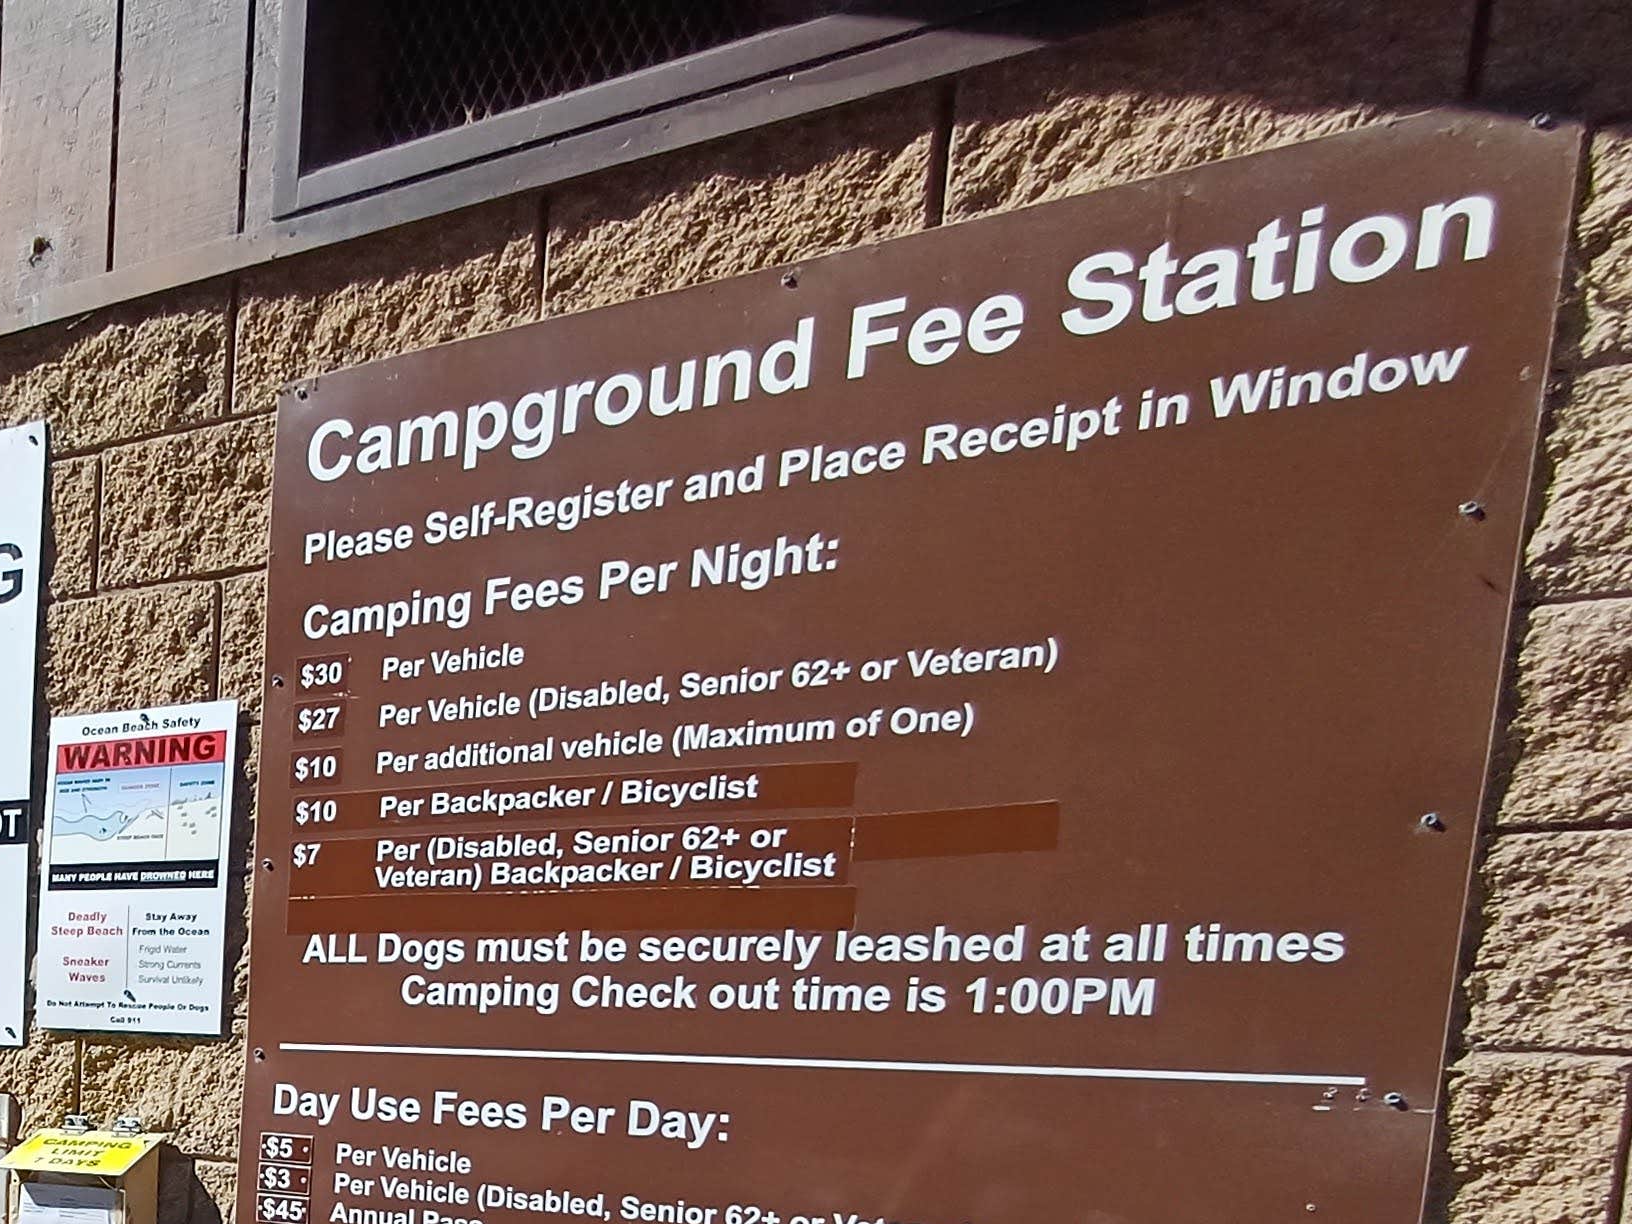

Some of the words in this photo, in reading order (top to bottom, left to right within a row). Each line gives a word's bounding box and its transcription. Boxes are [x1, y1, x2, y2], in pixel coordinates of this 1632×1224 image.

[308, 316, 814, 481] Campground
[848, 294, 1024, 378] Fee
[1062, 195, 1496, 334] Station
[305, 525, 413, 564] Please
[424, 478, 674, 544] Self-Register
[684, 454, 765, 502] and
[780, 442, 906, 486] Place
[922, 396, 1122, 464] Receipt
[1139, 389, 1189, 430] in
[1210, 346, 1468, 418] Window
[304, 590, 471, 638] Camping
[485, 576, 584, 614] Fees
[600, 560, 678, 599] Per
[691, 533, 839, 590] Night:
[302, 662, 342, 688] $30
[383, 658, 425, 680] Per
[431, 643, 524, 674] Vehicle
[298, 706, 340, 733] $27
[380, 704, 422, 727] Per
[428, 692, 520, 722] Vehicle
[530, 676, 669, 718] (Disabled,
[680, 667, 784, 698] Senior
[792, 660, 850, 688] 62+
[860, 658, 898, 681] or
[908, 638, 1058, 676] Veteran)
[82, 725, 118, 736] Ocean
[122, 720, 158, 733] Beach
[162, 716, 201, 729] Safety
[64, 734, 216, 770] WARNING
[296, 756, 336, 781] $10
[377, 752, 418, 774] Per
[424, 737, 554, 770] additional
[562, 729, 662, 758] vehicle
[672, 720, 835, 756] (Maximum
[846, 709, 884, 738] of
[890, 702, 974, 736] One)
[296, 800, 336, 825] $10
[380, 796, 424, 818] Per
[432, 785, 596, 816] Backpacker
[602, 781, 613, 804] /
[621, 774, 758, 808] Bicyclist
[294, 844, 320, 868] $7
[377, 840, 420, 862] Per
[428, 832, 563, 865] (Disabled,
[574, 829, 674, 854] Senior
[682, 826, 740, 850] 62+
[750, 829, 788, 848] or
[52, 873, 77, 883] MANY
[78, 872, 112, 882] PEOPLE
[114, 872, 138, 881] HAVE
[140, 870, 186, 882] DROWNED
[188, 870, 214, 879] HERE
[375, 863, 482, 890] Veteran)
[491, 858, 664, 888] Backpacker
[670, 856, 682, 880] /
[690, 852, 836, 884] Bicyclist
[68, 911, 107, 924] Deadly
[145, 913, 167, 923] Stay
[170, 913, 198, 923] Away
[51, 926, 84, 938] Steep
[87, 925, 123, 936] Beach
[132, 928, 155, 936] From
[159, 928, 175, 936] the
[178, 928, 210, 936] Ocean
[138, 945, 161, 955] Frigid
[163, 945, 188, 954] Water
[302, 934, 367, 962] ALL
[378, 934, 464, 970] Dogs
[476, 932, 569, 962] must
[580, 930, 626, 962] be
[638, 930, 822, 970] securely
[836, 925, 1026, 962] leashed
[1040, 926, 1090, 962] at
[1104, 924, 1168, 962] all
[1186, 924, 1344, 962] times
[62, 956, 110, 967] Sneaker
[138, 960, 164, 971] Strong
[166, 960, 202, 969] Currents
[69, 972, 106, 983] Waves
[138, 975, 169, 984] Survival
[171, 975, 204, 986] Unlikely
[402, 975, 559, 1014] Camping
[572, 975, 696, 1008] Check
[710, 978, 780, 1010] out
[792, 976, 890, 1012] time
[906, 977, 946, 1012] is
[966, 978, 1156, 1016] 1:00PM
[107, 1001, 116, 1009] To
[148, 1003, 175, 1011] People
[189, 1004, 209, 1012] Dogs
[110, 1016, 125, 1024] Call
[274, 1084, 340, 1125] Day
[352, 1088, 420, 1122] Use
[434, 1092, 526, 1128] Fees
[542, 1096, 616, 1134] Per
[628, 1100, 729, 1148] Day:
[43, 1139, 132, 1149] CAMPING
[52, 1148, 105, 1157] LIMIT
[48, 1158, 101, 1167] DAYS
[266, 1136, 293, 1158] $5
[336, 1144, 376, 1166] Per
[382, 1146, 472, 1174] Vehicle
[264, 1167, 291, 1189] $3
[334, 1173, 374, 1196] Per
[380, 1176, 469, 1204] Vehicle
[478, 1184, 610, 1221] (Disabled,
[263, 1198, 303, 1220] $45
